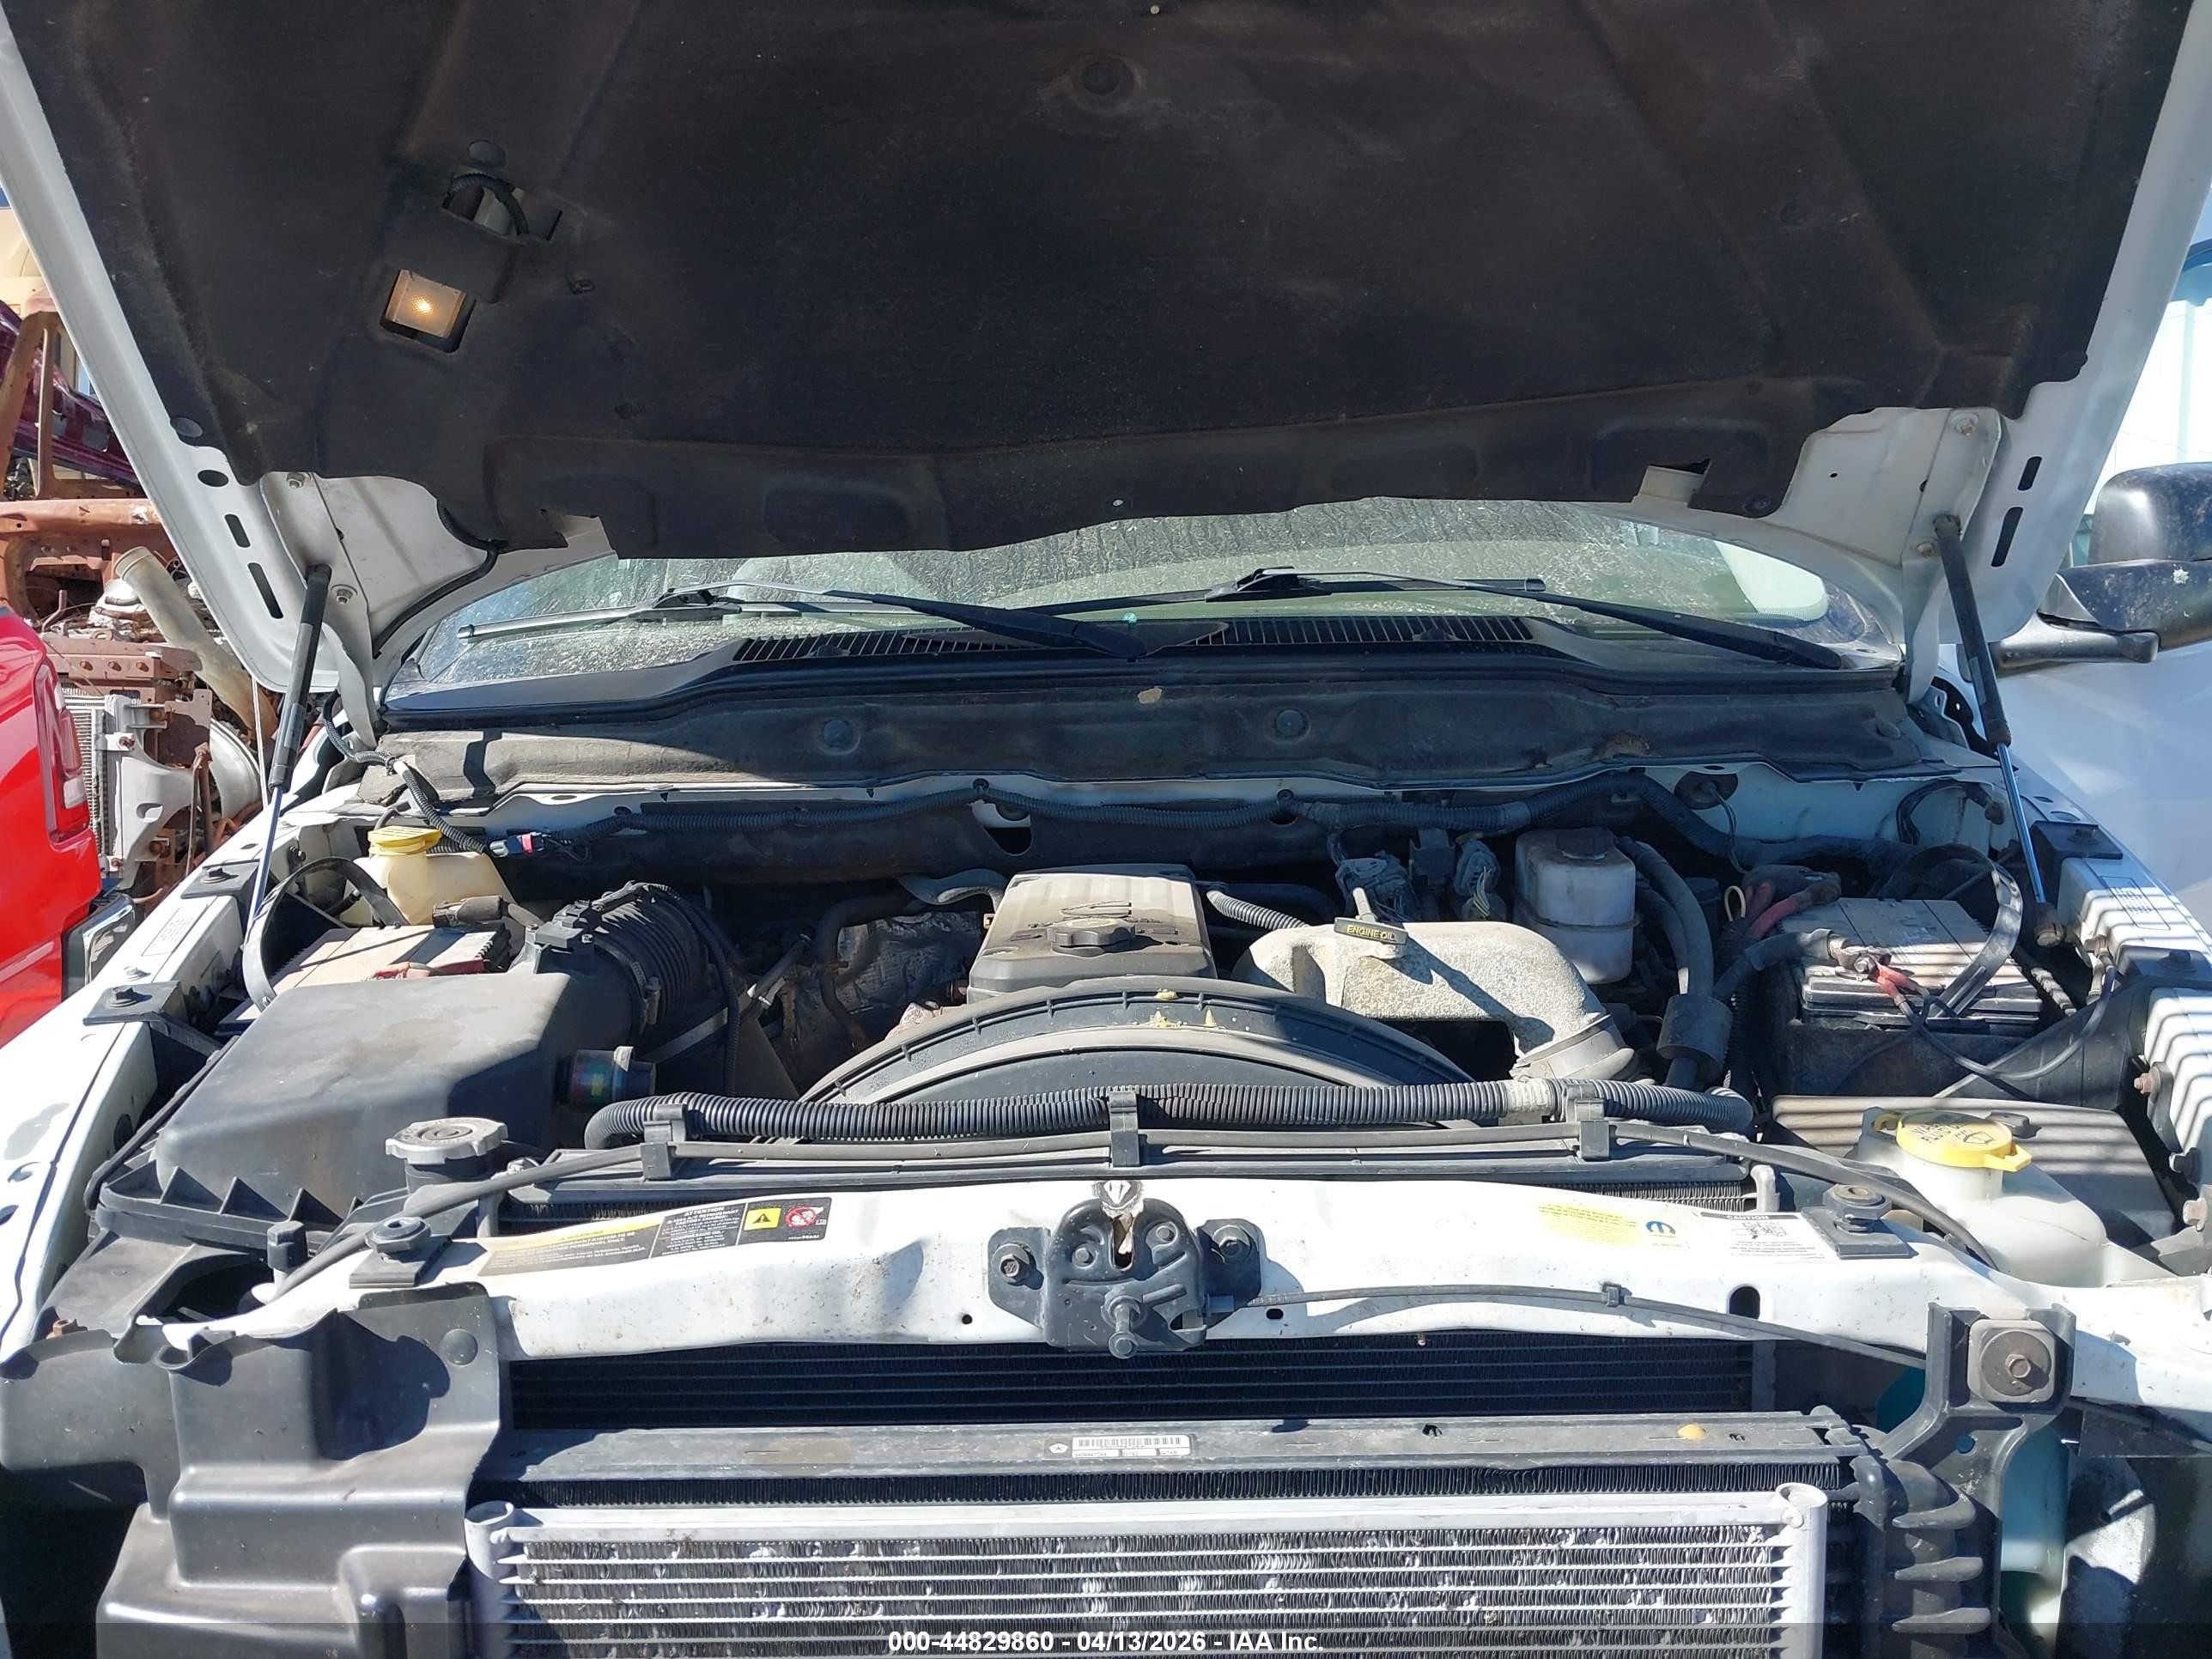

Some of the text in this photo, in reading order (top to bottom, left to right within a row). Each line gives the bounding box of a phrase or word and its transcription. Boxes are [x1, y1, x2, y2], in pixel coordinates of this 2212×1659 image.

[1346, 925, 1397, 942] ENGINE OIL
[684, 1206, 726, 1216] ATTENTION
